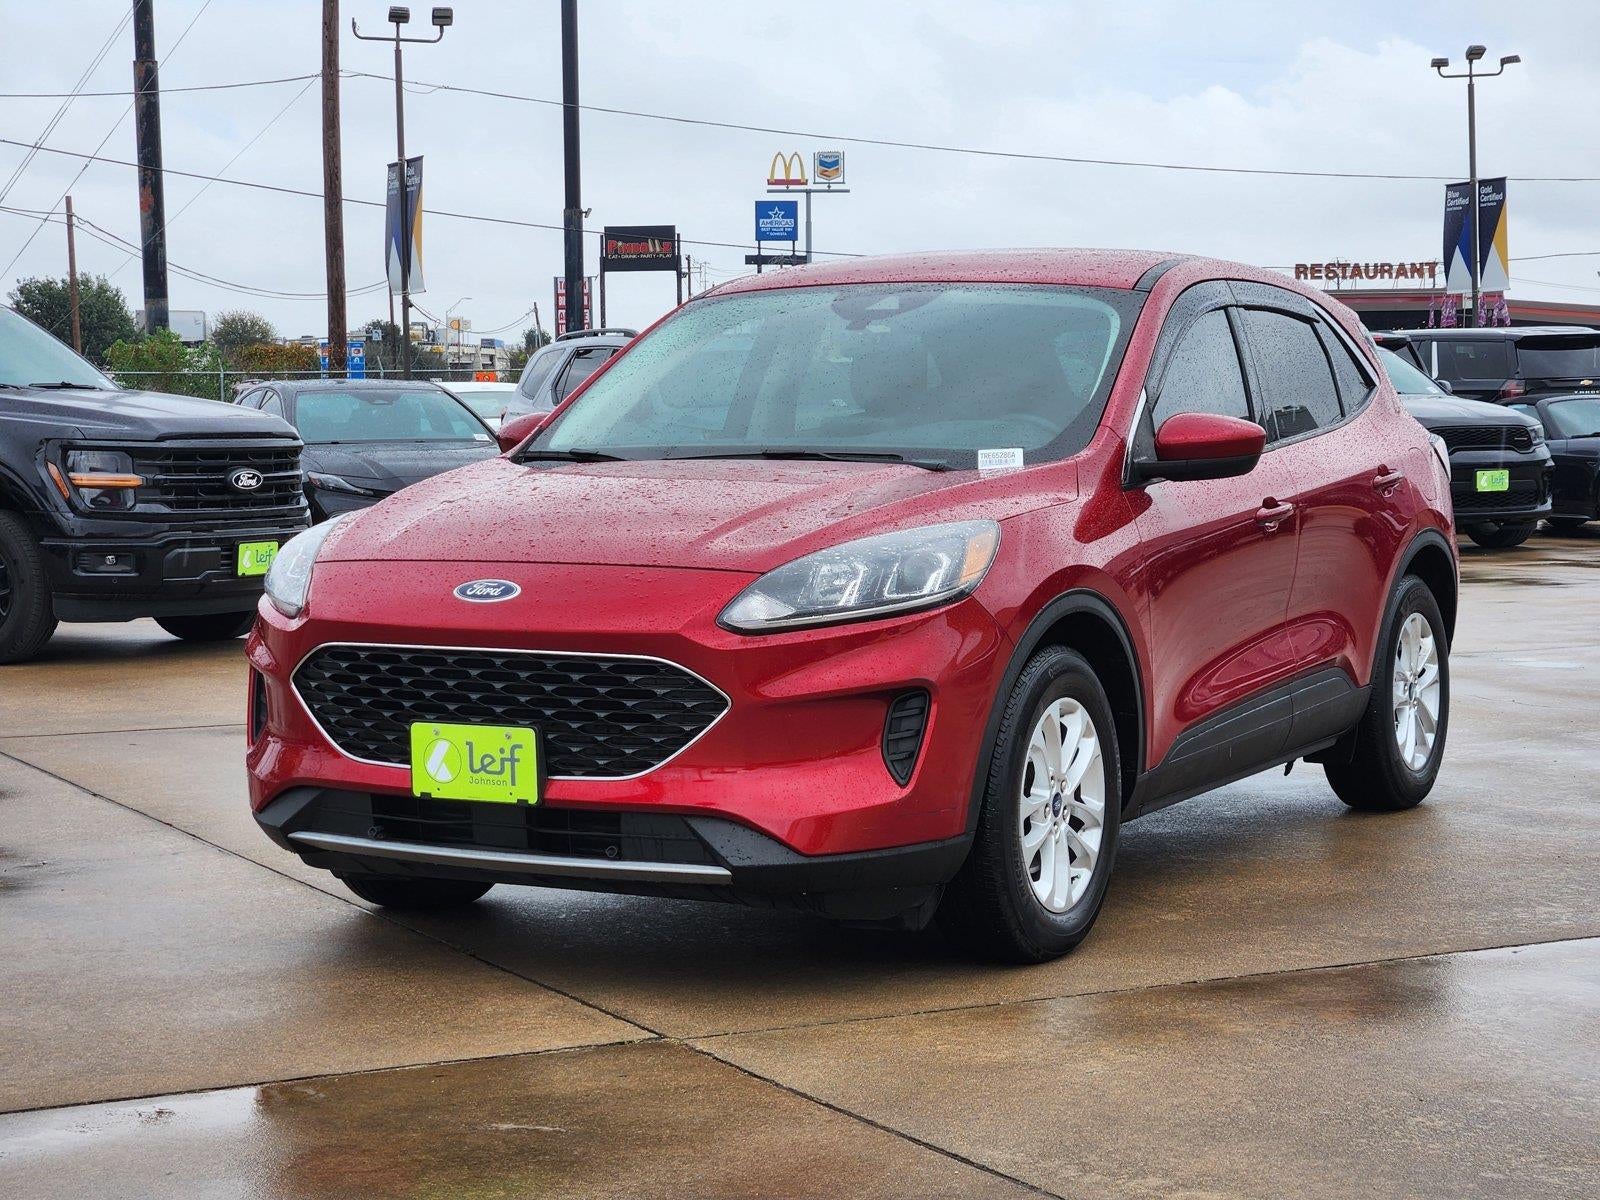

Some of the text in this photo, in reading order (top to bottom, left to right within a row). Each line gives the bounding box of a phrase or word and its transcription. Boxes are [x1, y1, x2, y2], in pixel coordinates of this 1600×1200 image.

[1480, 185, 1493, 194] Gold
[1447, 197, 1470, 206] Certified
[1480, 192, 1503, 202] Certified
[760, 219, 794, 227] AMERICAS
[1294, 262, 1438, 280] RESTAURANT
[238, 473, 258, 486] Ford
[255, 548, 274, 564] leif
[467, 581, 506, 596] Ford
[465, 740, 524, 787] leif
[468, 776, 508, 787] Johnson
